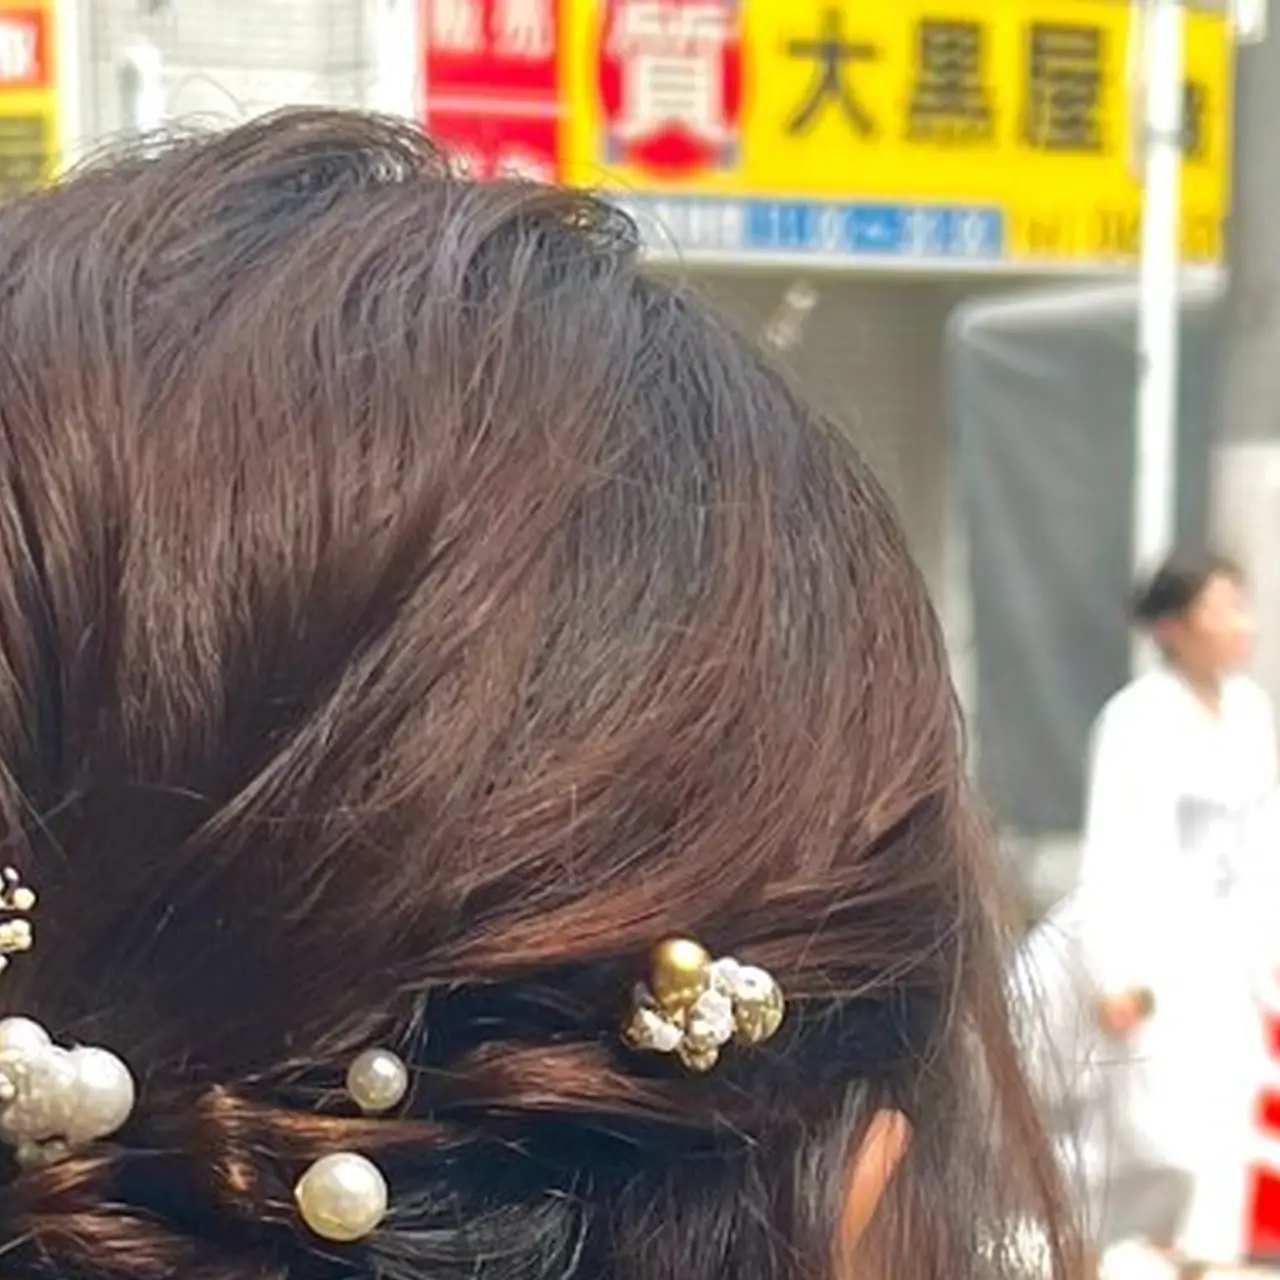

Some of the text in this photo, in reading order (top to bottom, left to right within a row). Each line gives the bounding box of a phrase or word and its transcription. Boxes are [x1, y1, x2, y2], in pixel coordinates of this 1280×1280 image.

[605, 0, 740, 142] 質
[782, 6, 1108, 156] 大黒屋
